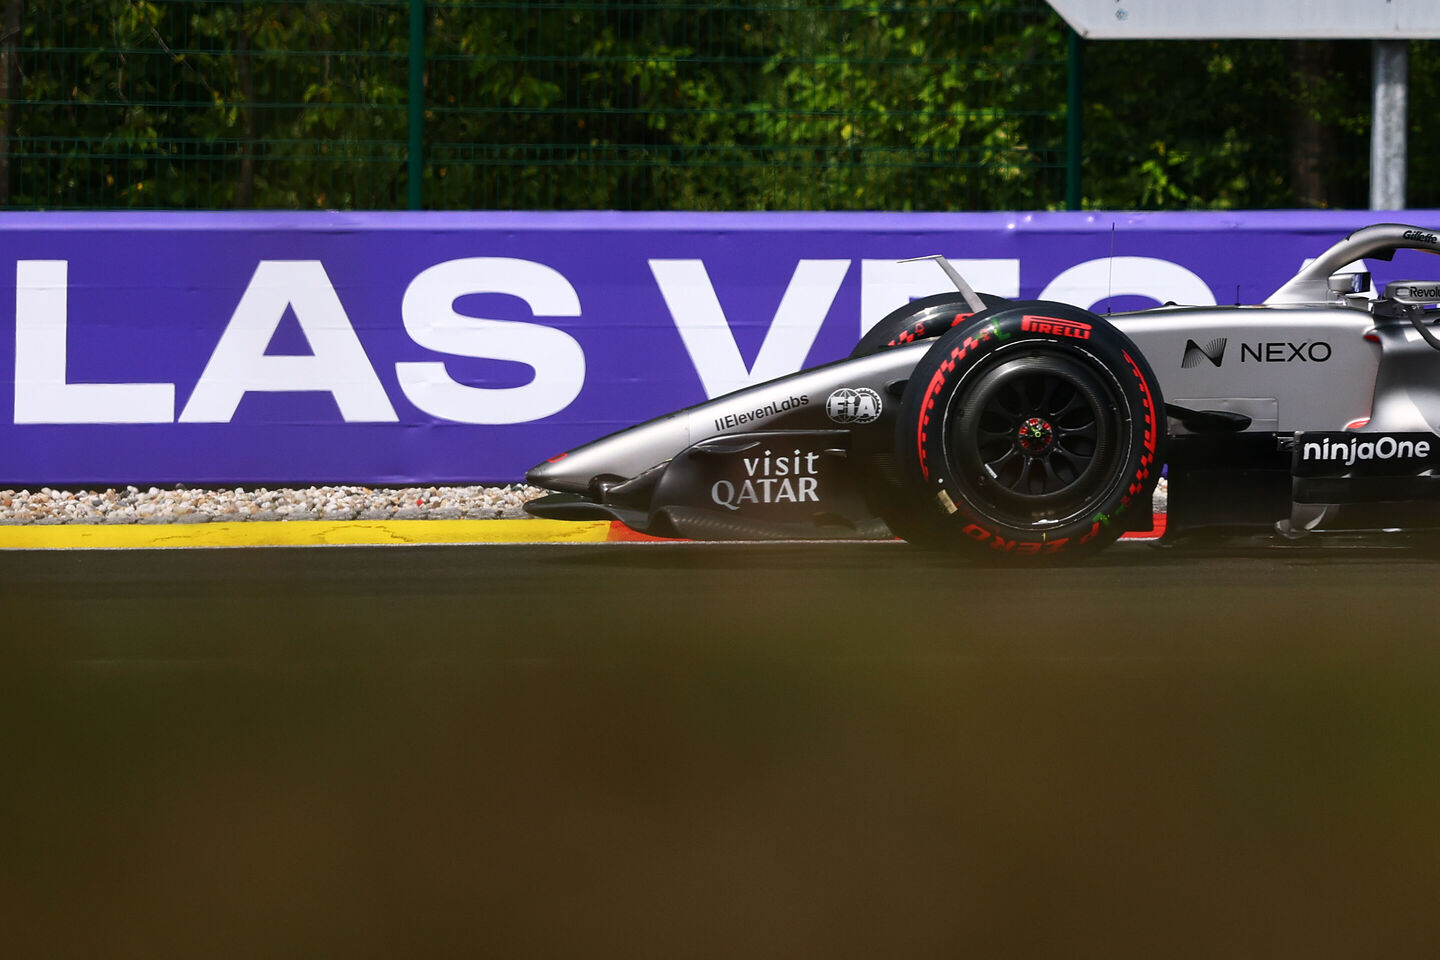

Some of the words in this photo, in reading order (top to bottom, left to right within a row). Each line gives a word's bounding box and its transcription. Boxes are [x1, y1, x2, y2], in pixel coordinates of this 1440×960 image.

[13, 257, 586, 425] LAS
[1021, 314, 1093, 340] PIRELLI
[1240, 341, 1333, 363] NEXO
[743, 449, 820, 477] visit
[1303, 436, 1430, 466] ninjaOne
[711, 477, 820, 511] QATAR
